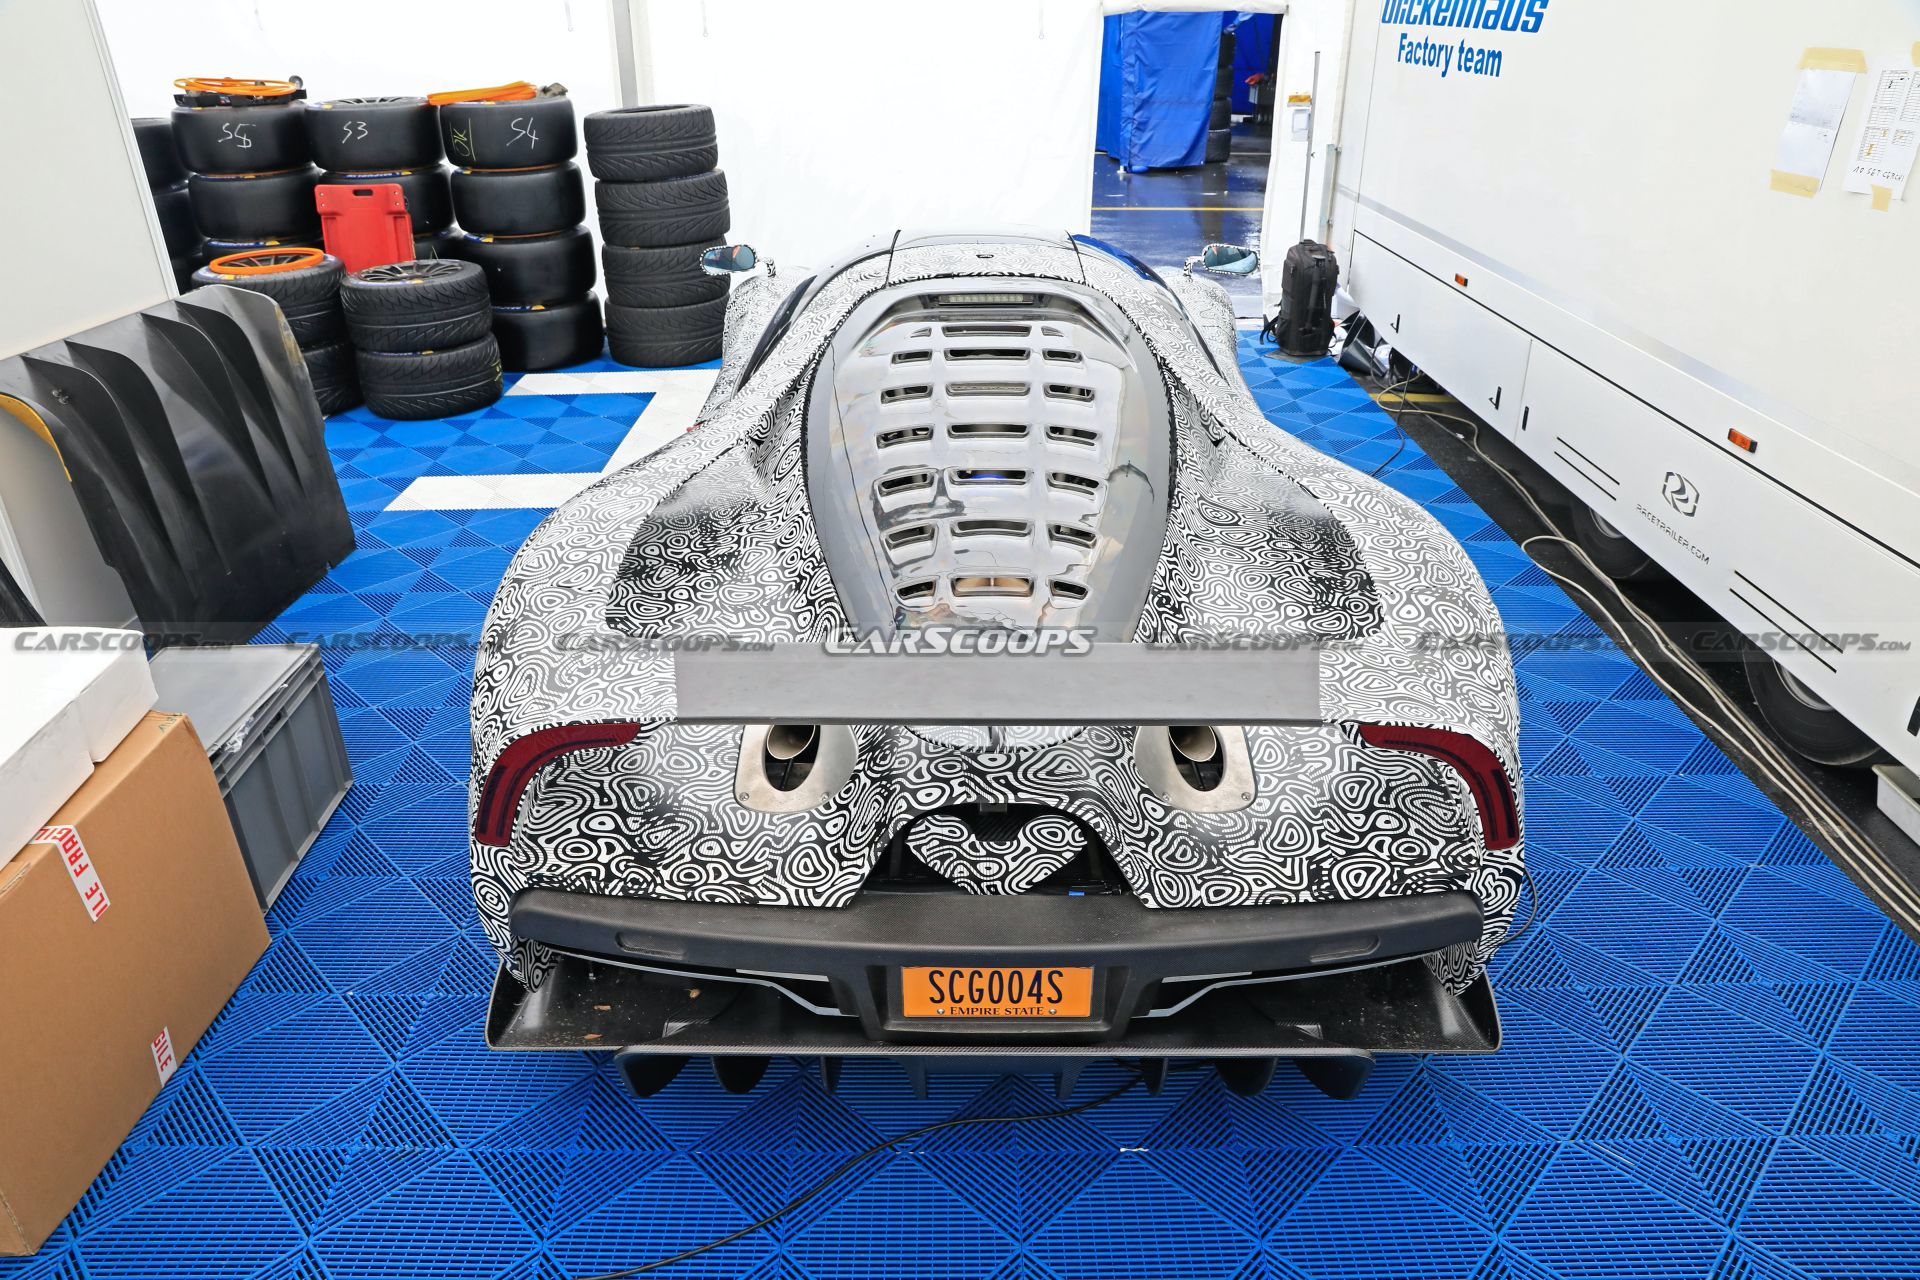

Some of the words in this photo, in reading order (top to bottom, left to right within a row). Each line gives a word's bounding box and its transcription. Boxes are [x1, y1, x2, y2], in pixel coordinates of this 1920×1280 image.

[1397, 33, 1454, 78] Factory
[1457, 39, 1503, 77] team
[1636, 503, 1710, 565] RACETRAILER.COM
[929, 969, 1064, 1004] SCG004S
[950, 1006, 1000, 1015] EMPIRE
[1005, 1006, 1044, 1015] STATE
